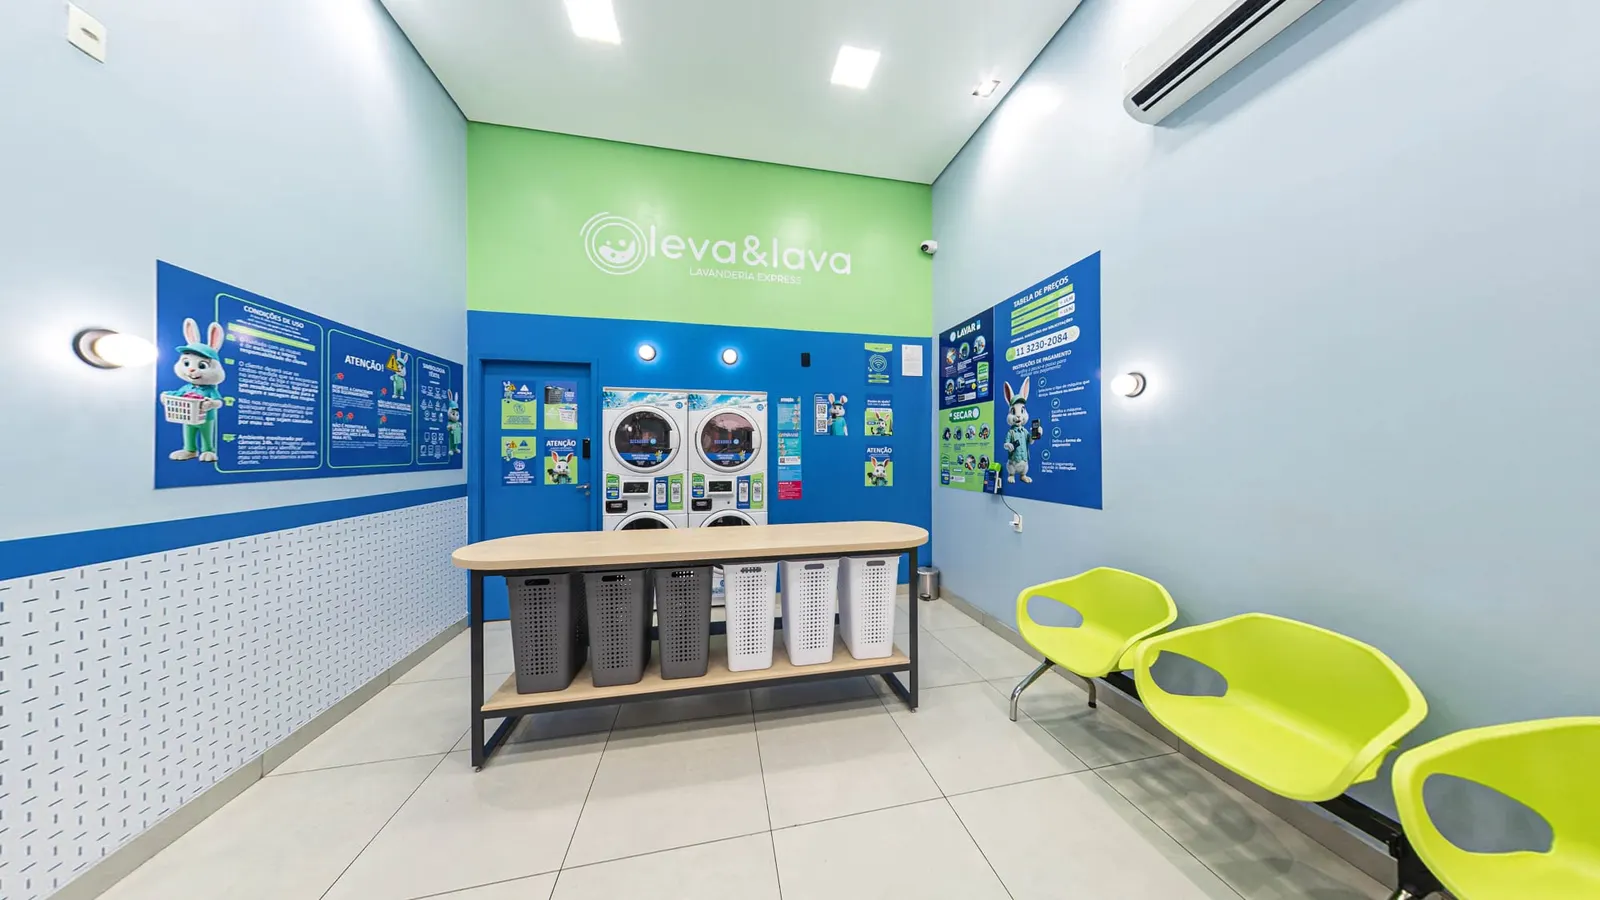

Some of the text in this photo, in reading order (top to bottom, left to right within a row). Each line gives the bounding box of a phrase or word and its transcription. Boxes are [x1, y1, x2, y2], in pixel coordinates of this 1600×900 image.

[650, 225, 851, 275] leva&lava
[689, 267, 802, 285] LAVANDERIA EXPRESS
[1013, 294, 1033, 308] TABELA
[1034, 290, 1042, 298] DE
[1043, 276, 1069, 293] PREÇOS
[244, 306, 281, 321] CONDIÇÕES
[292, 320, 304, 328] USO
[957, 323, 975, 338] LAVAR
[1016, 332, 1068, 356] 11 3230-2084
[345, 355, 384, 372] ATENÇÃO!
[1013, 360, 1035, 370] INSTRUÇÕES
[1042, 349, 1071, 363] PAGAMENTO
[953, 410, 972, 420] SECAR
[546, 439, 576, 448] ATENÇÃO
[867, 446, 892, 454] ATENÇÃO
